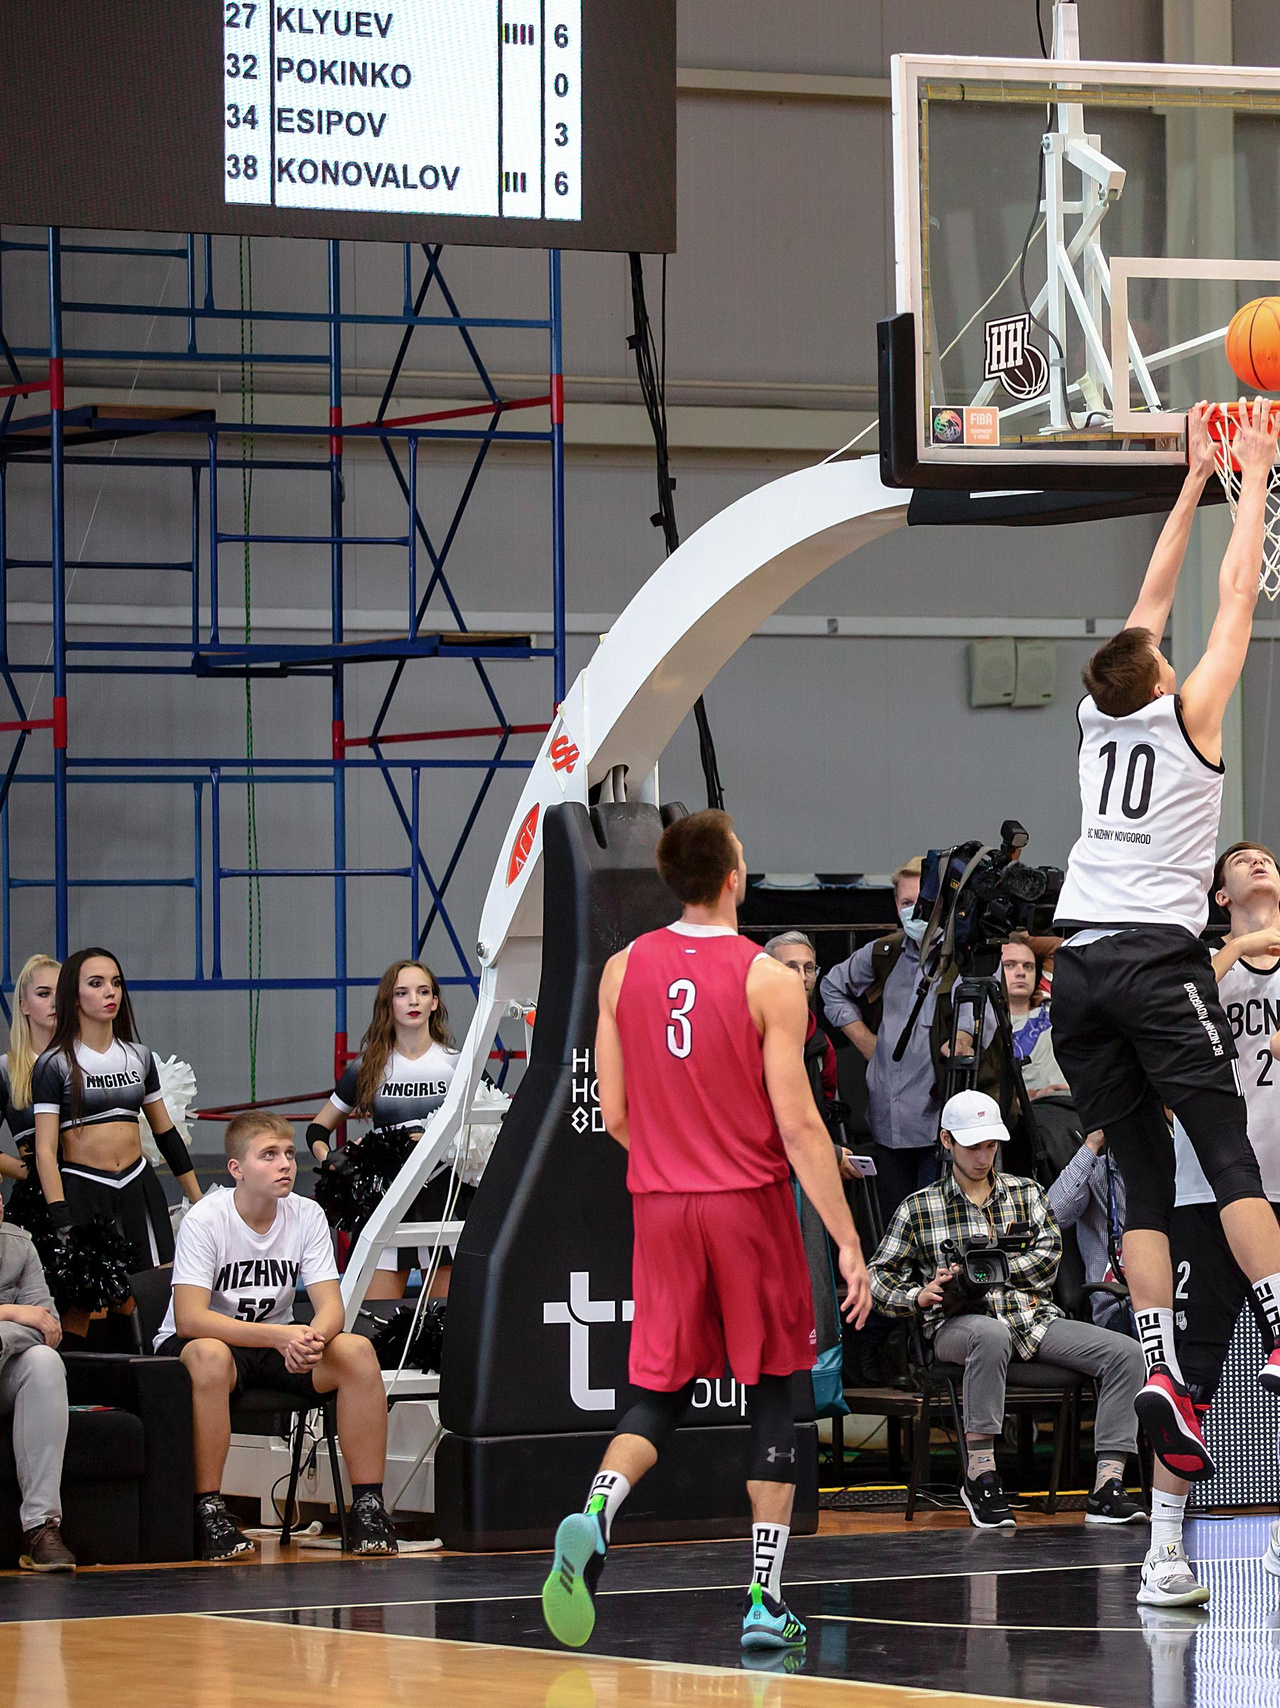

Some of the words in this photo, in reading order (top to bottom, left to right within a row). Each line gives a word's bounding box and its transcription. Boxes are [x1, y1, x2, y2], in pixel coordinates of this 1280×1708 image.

[225, 2, 257, 29] 27
[276, 7, 393, 38] KLYUEV
[554, 24, 569, 48] 6
[226, 53, 258, 79] 32
[276, 57, 412, 89] POKINKO
[554, 73, 569, 97] 0
[226, 104, 258, 129] 34
[277, 107, 387, 137] ESIPOV
[554, 122, 569, 147] 3
[226, 154, 258, 180] 38
[277, 158, 460, 191] KONOVALOV
[554, 171, 569, 196] 6
[970, 413, 993, 425] FIBA
[1098, 740, 1156, 820] 10
[1087, 827, 1094, 839] BC
[1094, 828, 1115, 841] NIZHNY
[1115, 831, 1152, 845] NOVGOROD
[665, 978, 697, 1060] 3
[1183, 982, 1208, 1020] NOVGOROD
[1200, 1020, 1220, 1045] NIZHNY
[1212, 1044, 1225, 1057] BC
[86, 1070, 141, 1088] NNGIRLS
[1256, 1049, 1274, 1087] 2
[382, 1081, 447, 1097] NNGIRLS
[214, 1259, 300, 1291] NIZHNY
[1175, 1260, 1191, 1299] 2
[234, 1297, 277, 1323] 52
